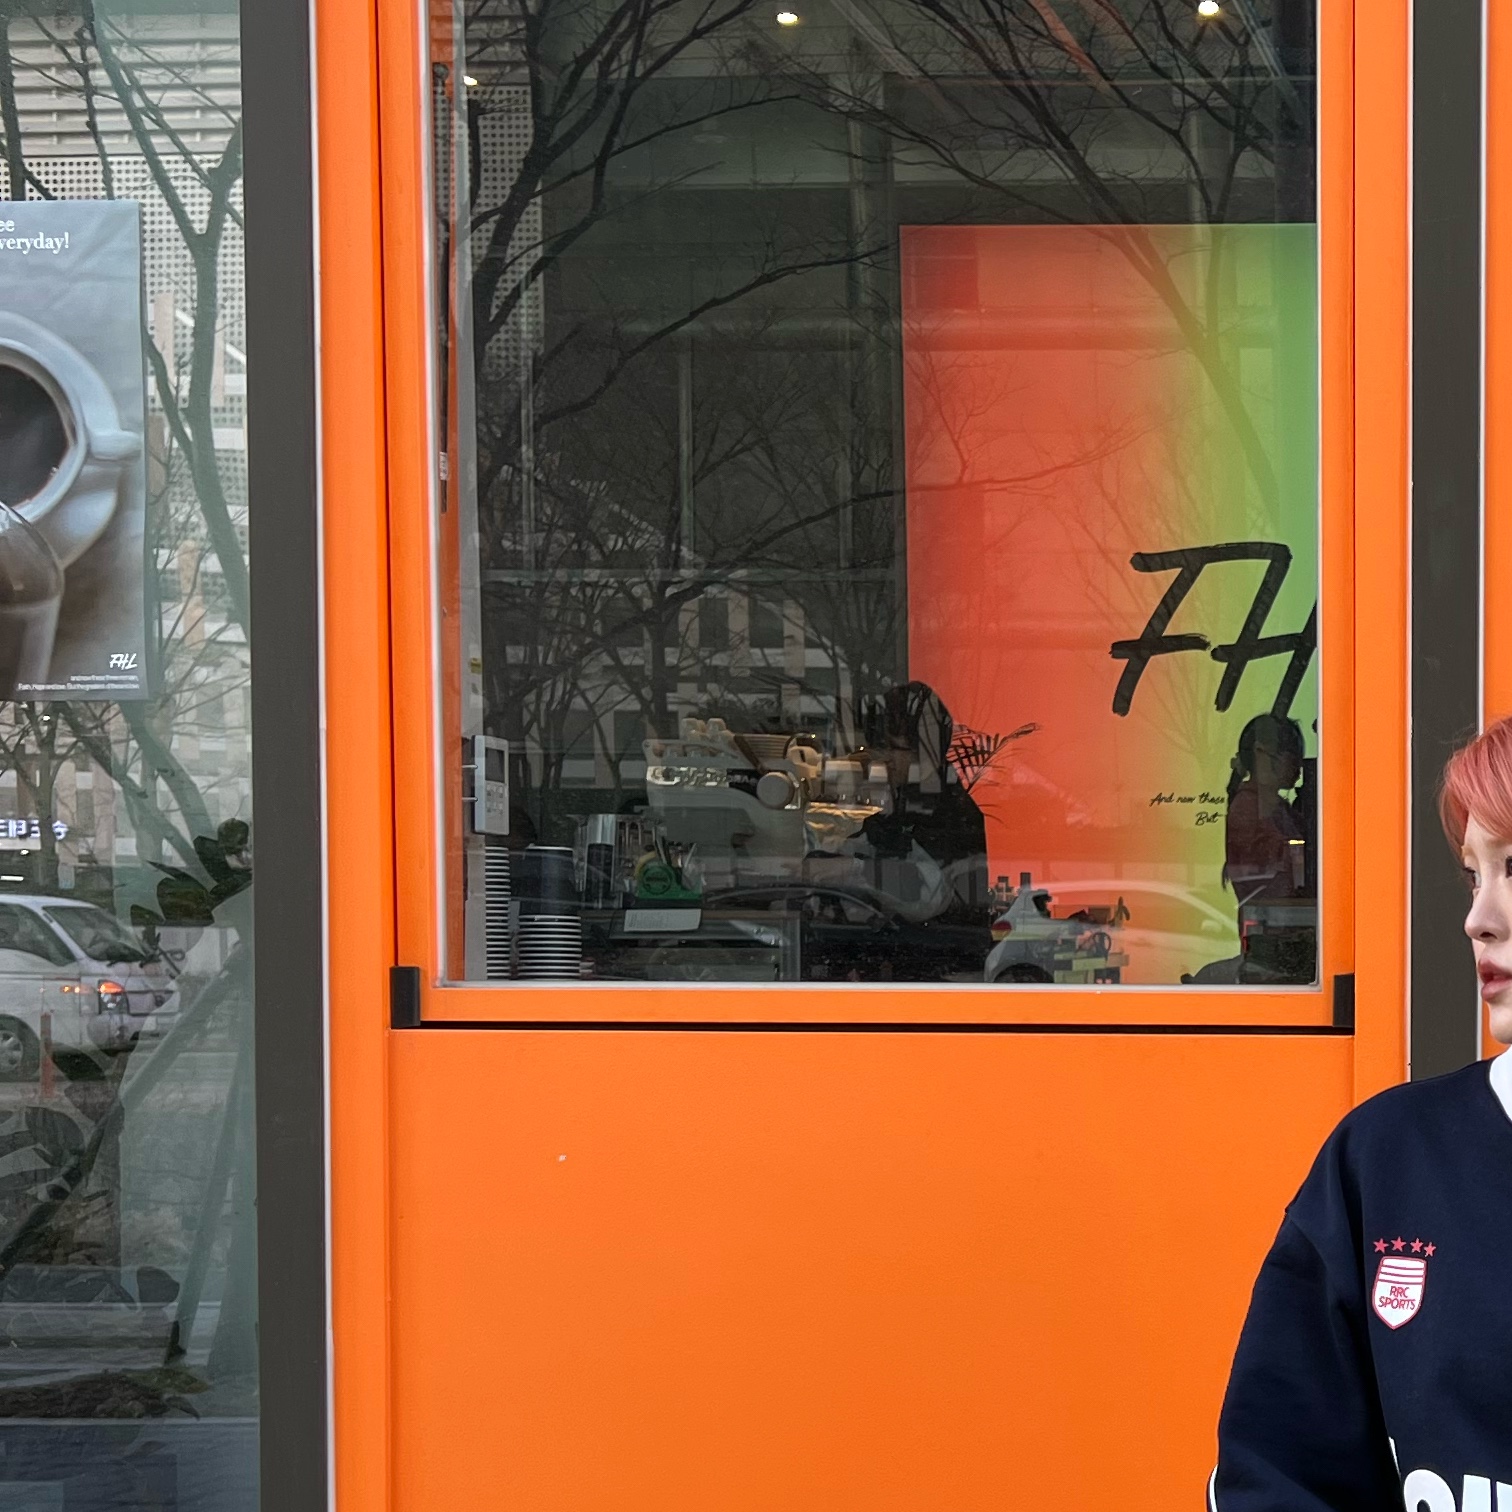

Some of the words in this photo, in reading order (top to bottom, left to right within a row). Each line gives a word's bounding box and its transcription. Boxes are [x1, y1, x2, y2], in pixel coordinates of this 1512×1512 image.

[1149, 792, 1175, 807] And
[1195, 812, 1223, 826] But
[1390, 1286, 1410, 1298] RRC
[1378, 1296, 1416, 1310] SPORTS
